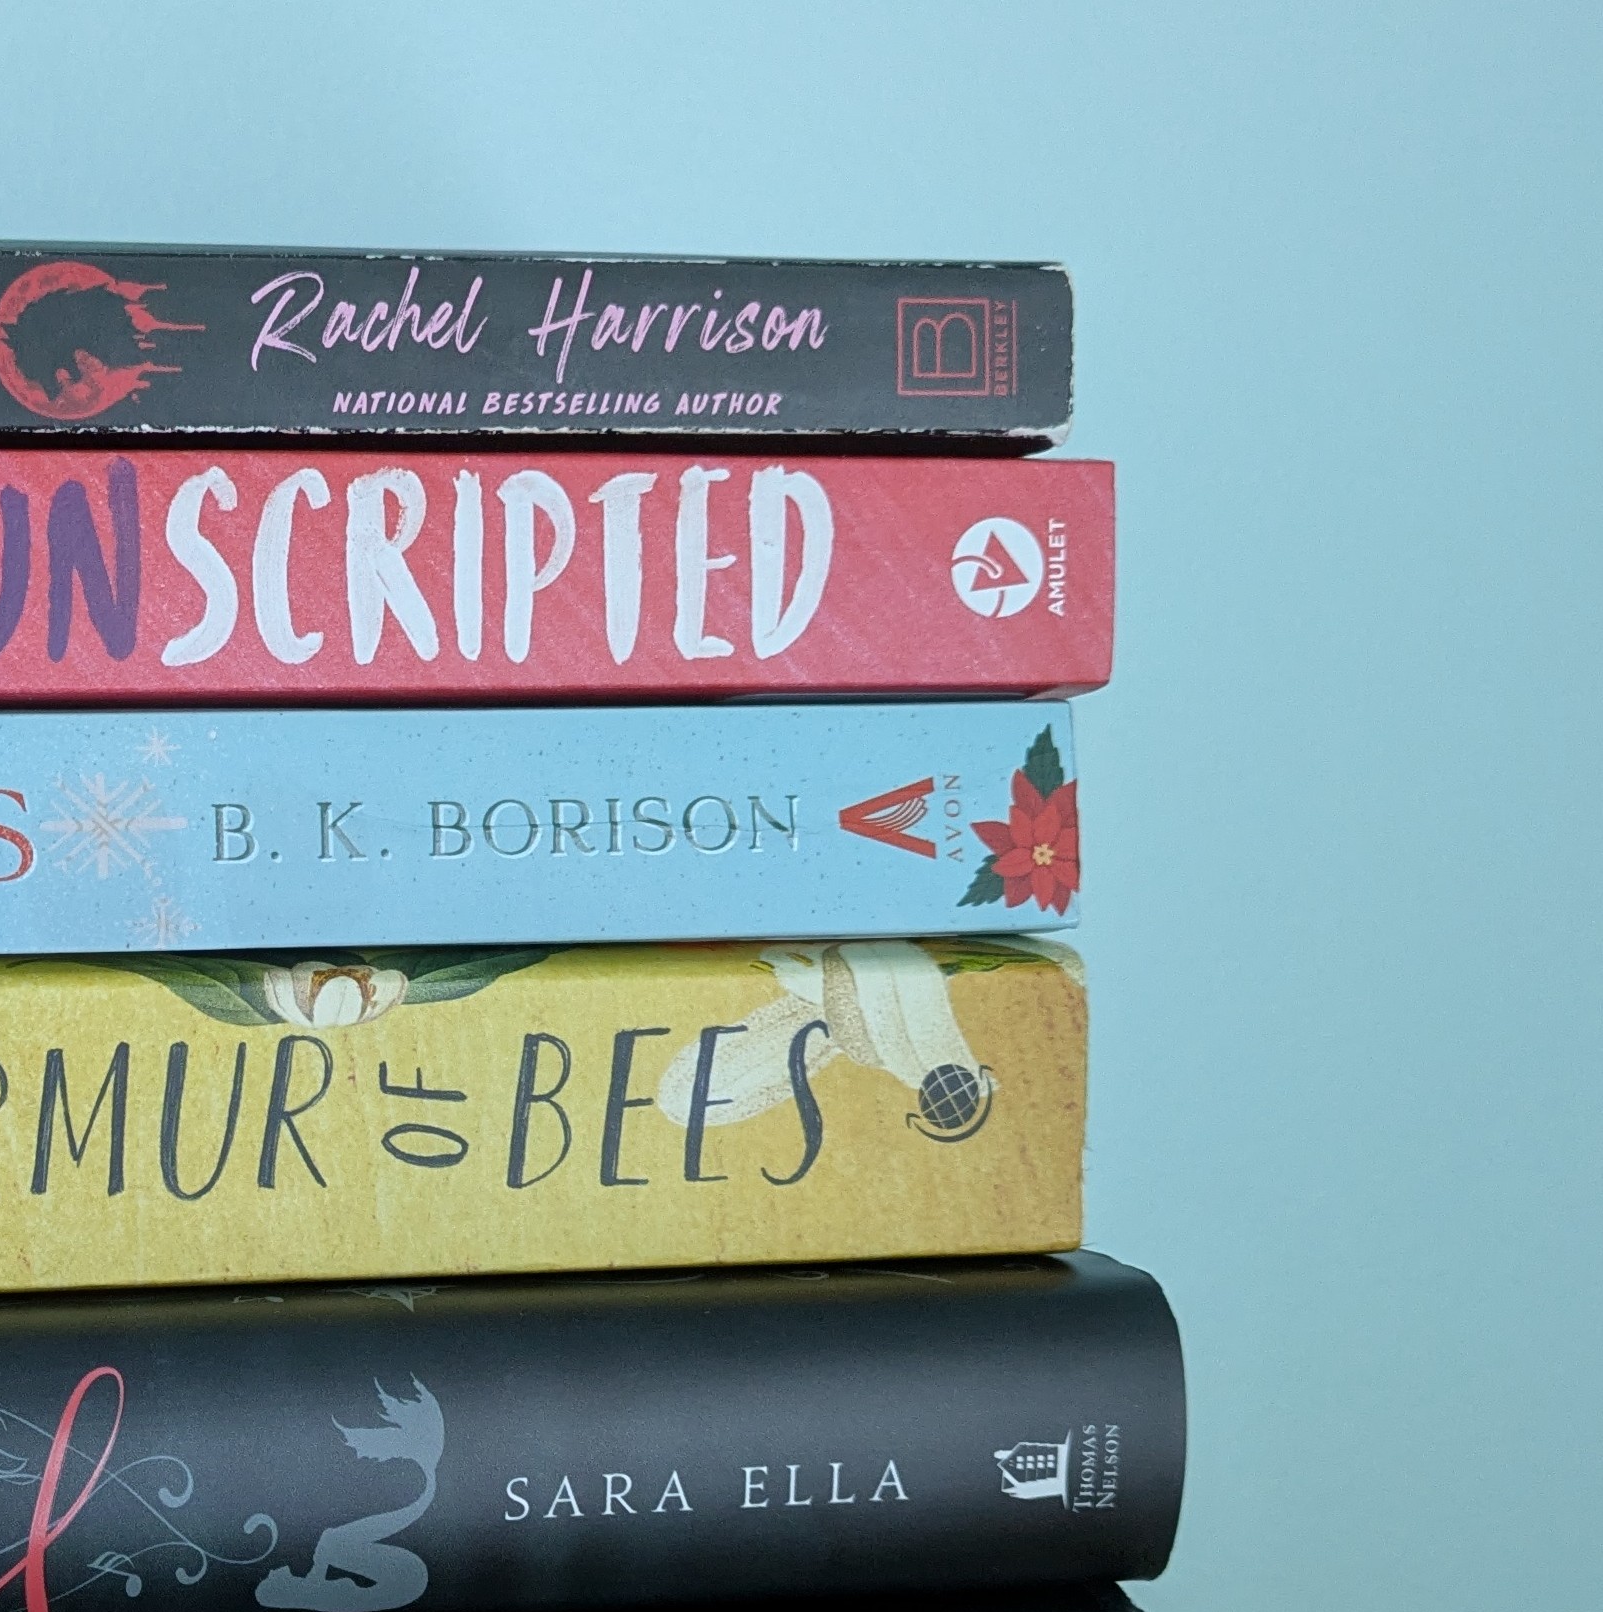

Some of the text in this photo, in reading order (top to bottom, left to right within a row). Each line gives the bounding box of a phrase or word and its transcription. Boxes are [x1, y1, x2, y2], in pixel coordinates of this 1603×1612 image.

[251, 266, 829, 384] Rachel Harrison
[994, 301, 1008, 396] BERKLEY
[333, 391, 782, 415] NATIONAL BESTSELLING AUTHOR
[1048, 519, 1066, 617] AMULET
[212, 792, 798, 866] B. K. BORISON
[943, 775, 963, 863] AVON
[381, 1062, 468, 1168] OF
[506, 1018, 829, 1190] BEES
[502, 1457, 910, 1523] SARA ELLA
